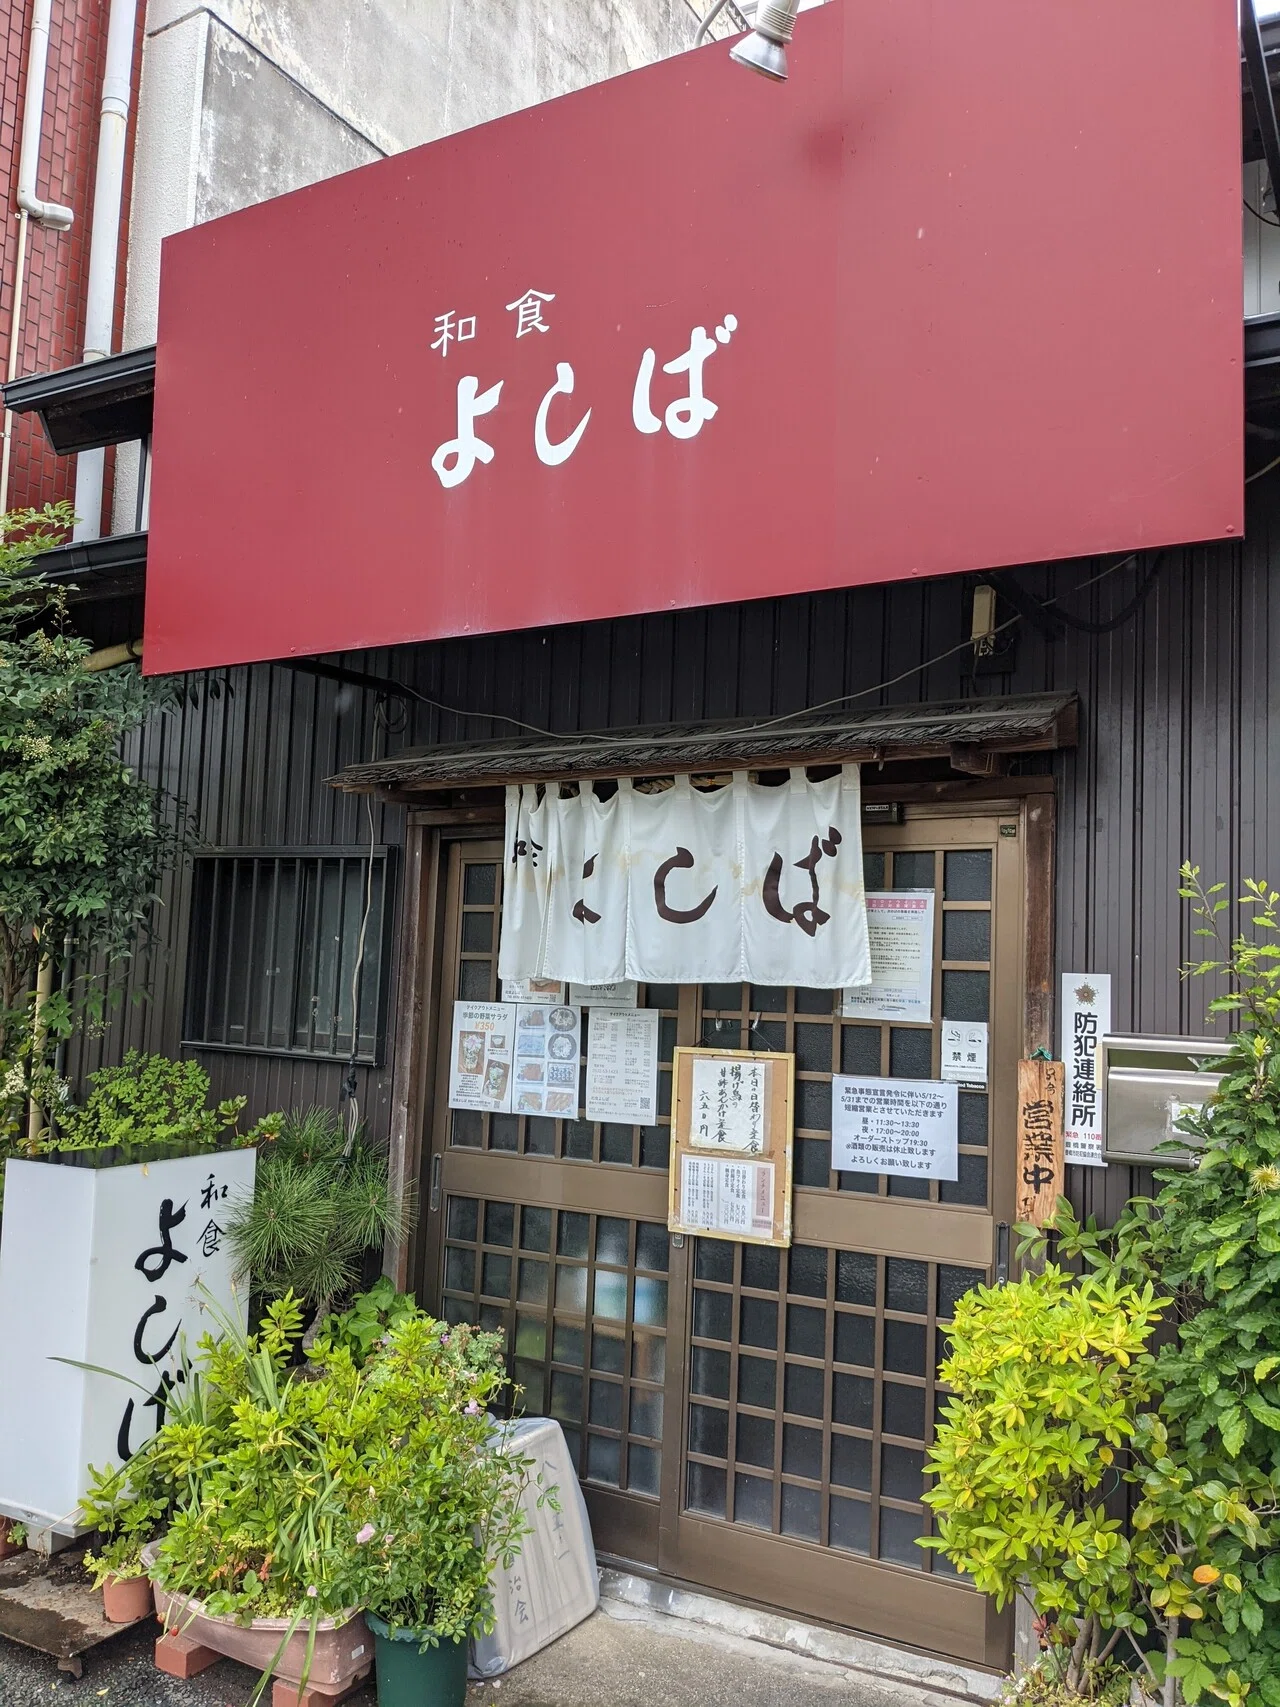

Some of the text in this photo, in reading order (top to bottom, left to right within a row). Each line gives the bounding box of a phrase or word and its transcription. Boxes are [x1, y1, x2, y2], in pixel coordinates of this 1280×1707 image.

[431, 289, 556, 357] 和食
[431, 314, 738, 488] よしば
[462, 1011, 508, 1021] 季節の野菜サラダ
[952, 1051, 977, 1063] 禁煙
[1071, 1012, 1098, 1128] 防犯連絡所
[844, 1104, 944, 1118] 短縮営業とさせていただきます
[1022, 1099, 1055, 1195] 営業中
[1065, 1131, 1079, 1139] 緊急
[851, 1155, 932, 1169] よろしくお願い致します
[196, 1173, 228, 1257] 和食
